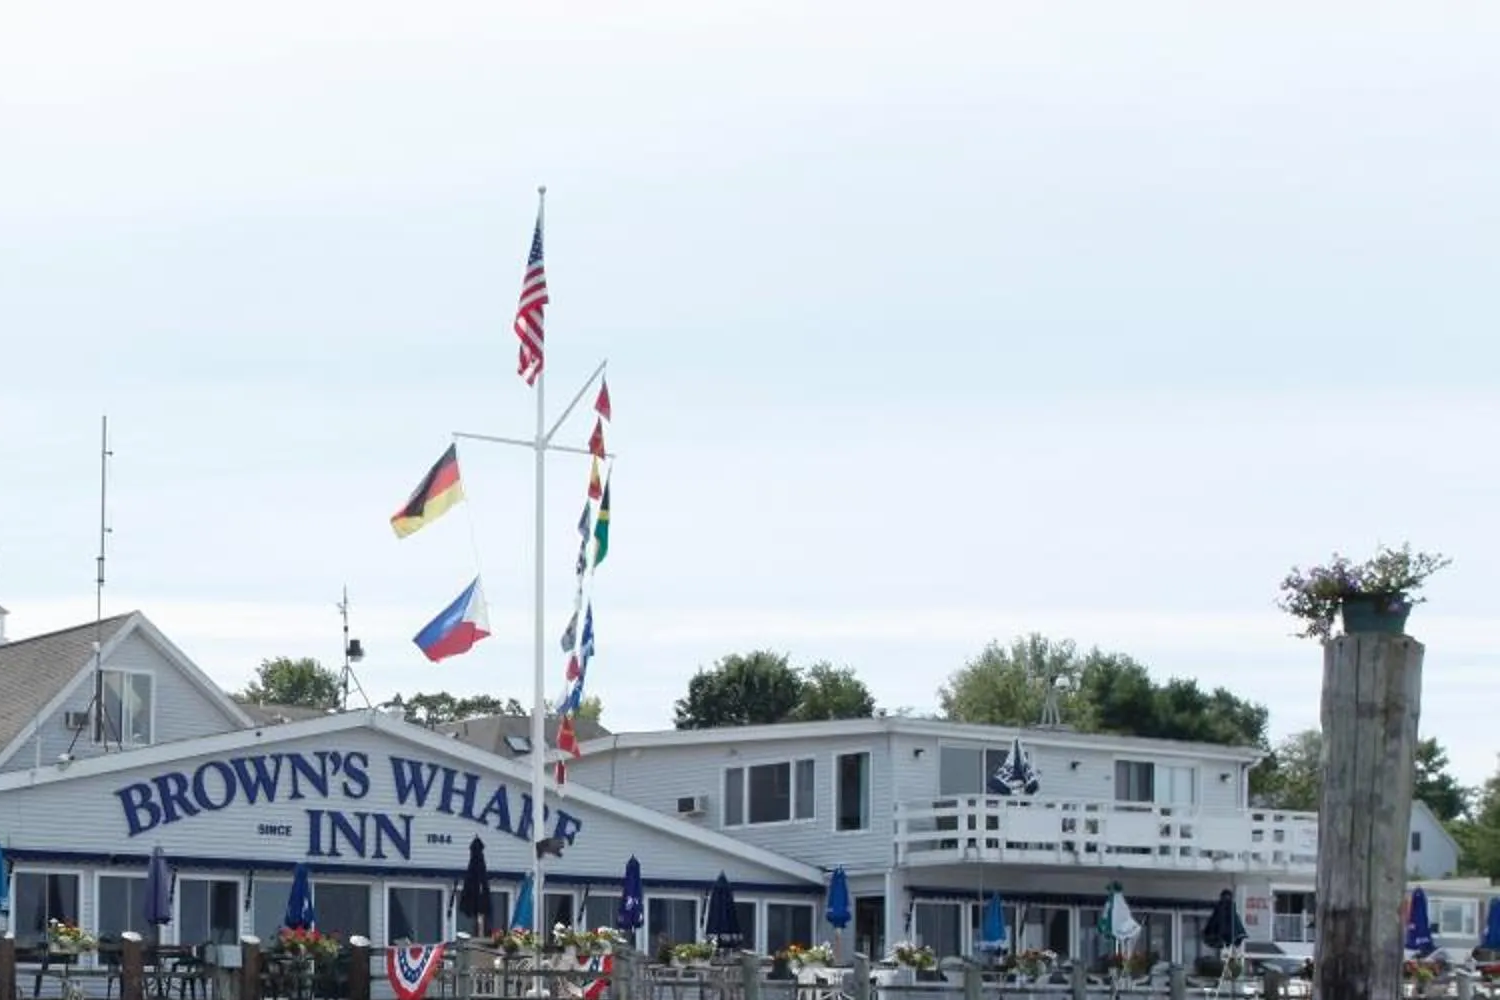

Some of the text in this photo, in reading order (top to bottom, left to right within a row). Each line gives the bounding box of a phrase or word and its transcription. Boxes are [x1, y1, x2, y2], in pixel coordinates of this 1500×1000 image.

[114, 751, 583, 846] BROWN'S WHARF
[257, 823, 293, 837] SINCE
[304, 808, 414, 860] INN
